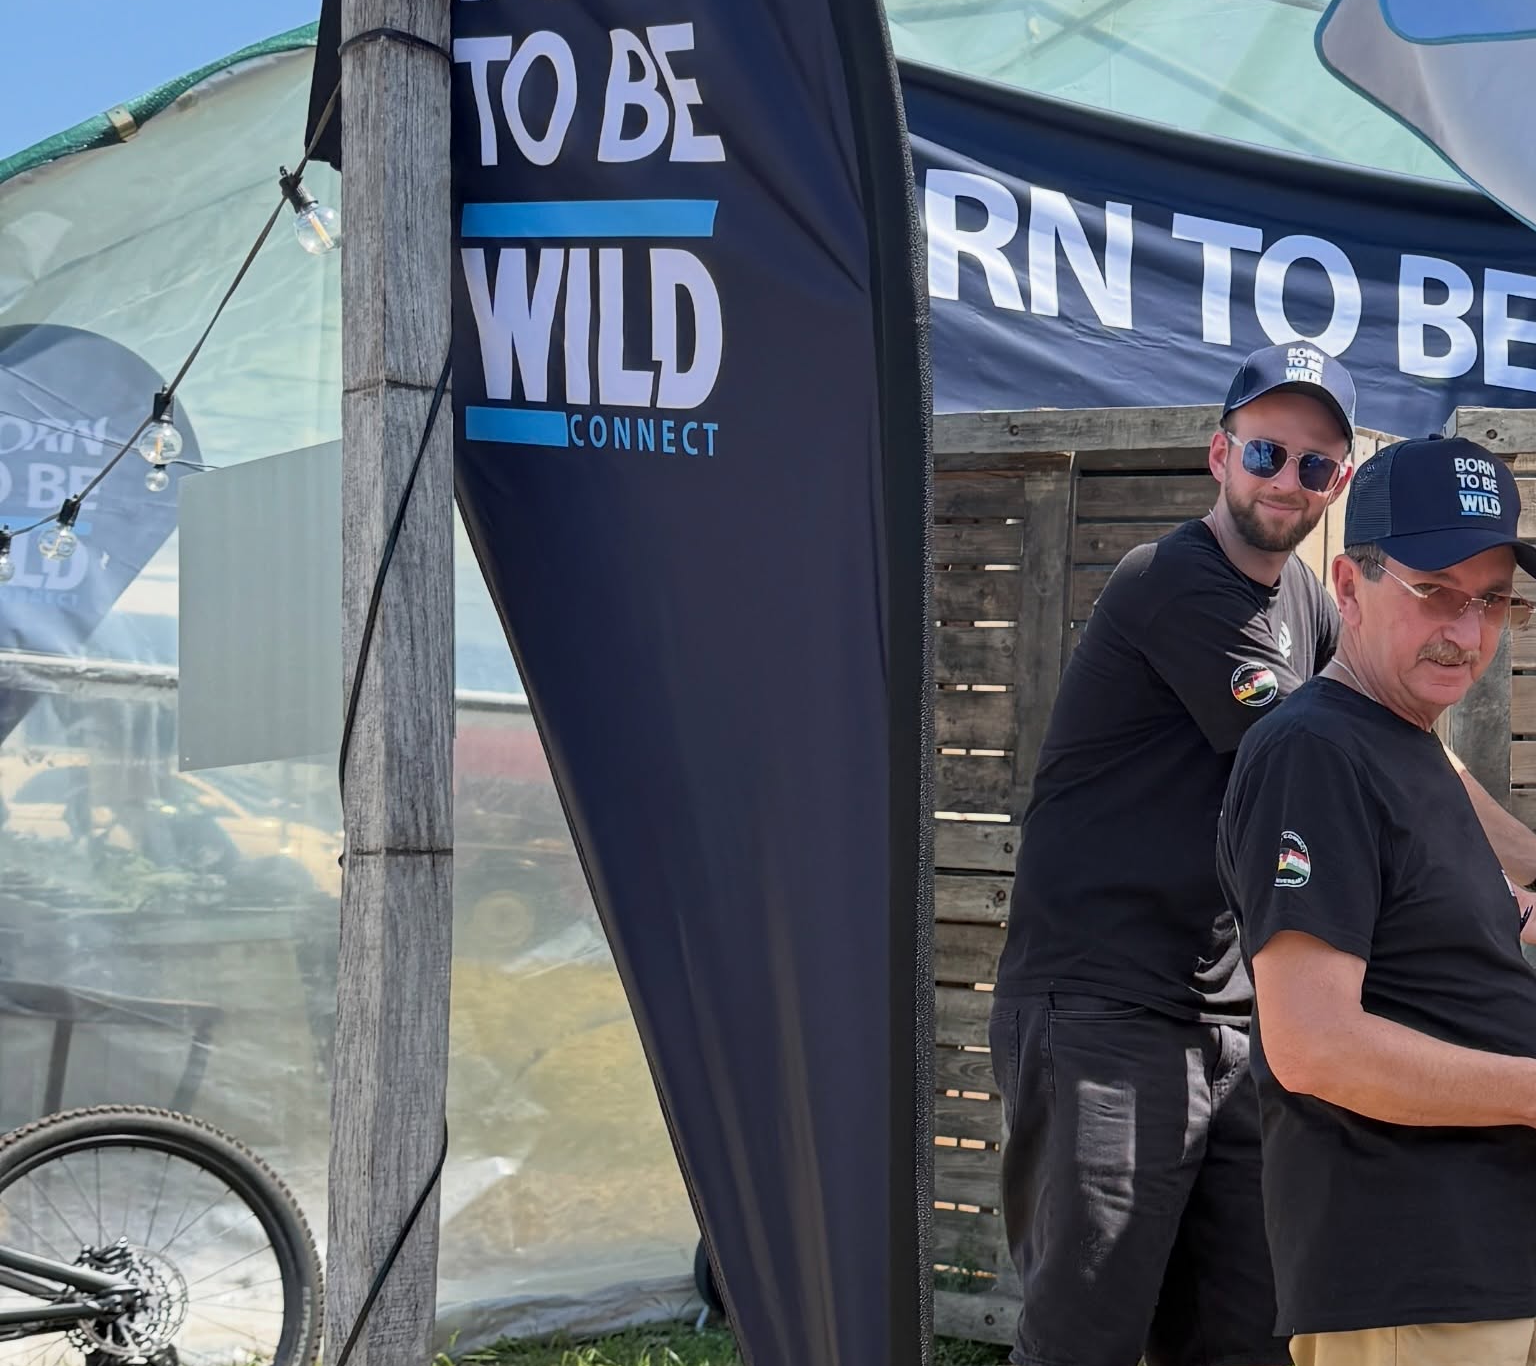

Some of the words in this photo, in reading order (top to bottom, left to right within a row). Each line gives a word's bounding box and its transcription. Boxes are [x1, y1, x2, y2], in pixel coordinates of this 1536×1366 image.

[453, 31, 577, 166] TO
[598, 22, 726, 163] BE
[1171, 212, 1362, 358] TO
[461, 247, 724, 410] WILD
[1287, 357, 1306, 367] TO
[570, 414, 719, 457] CONNECT
[27, 463, 102, 510] BE
[1454, 457, 1496, 478] BORN
[1456, 474, 1480, 489] TO
[1482, 476, 1500, 494] BE
[1459, 494, 1501, 516] WILD
